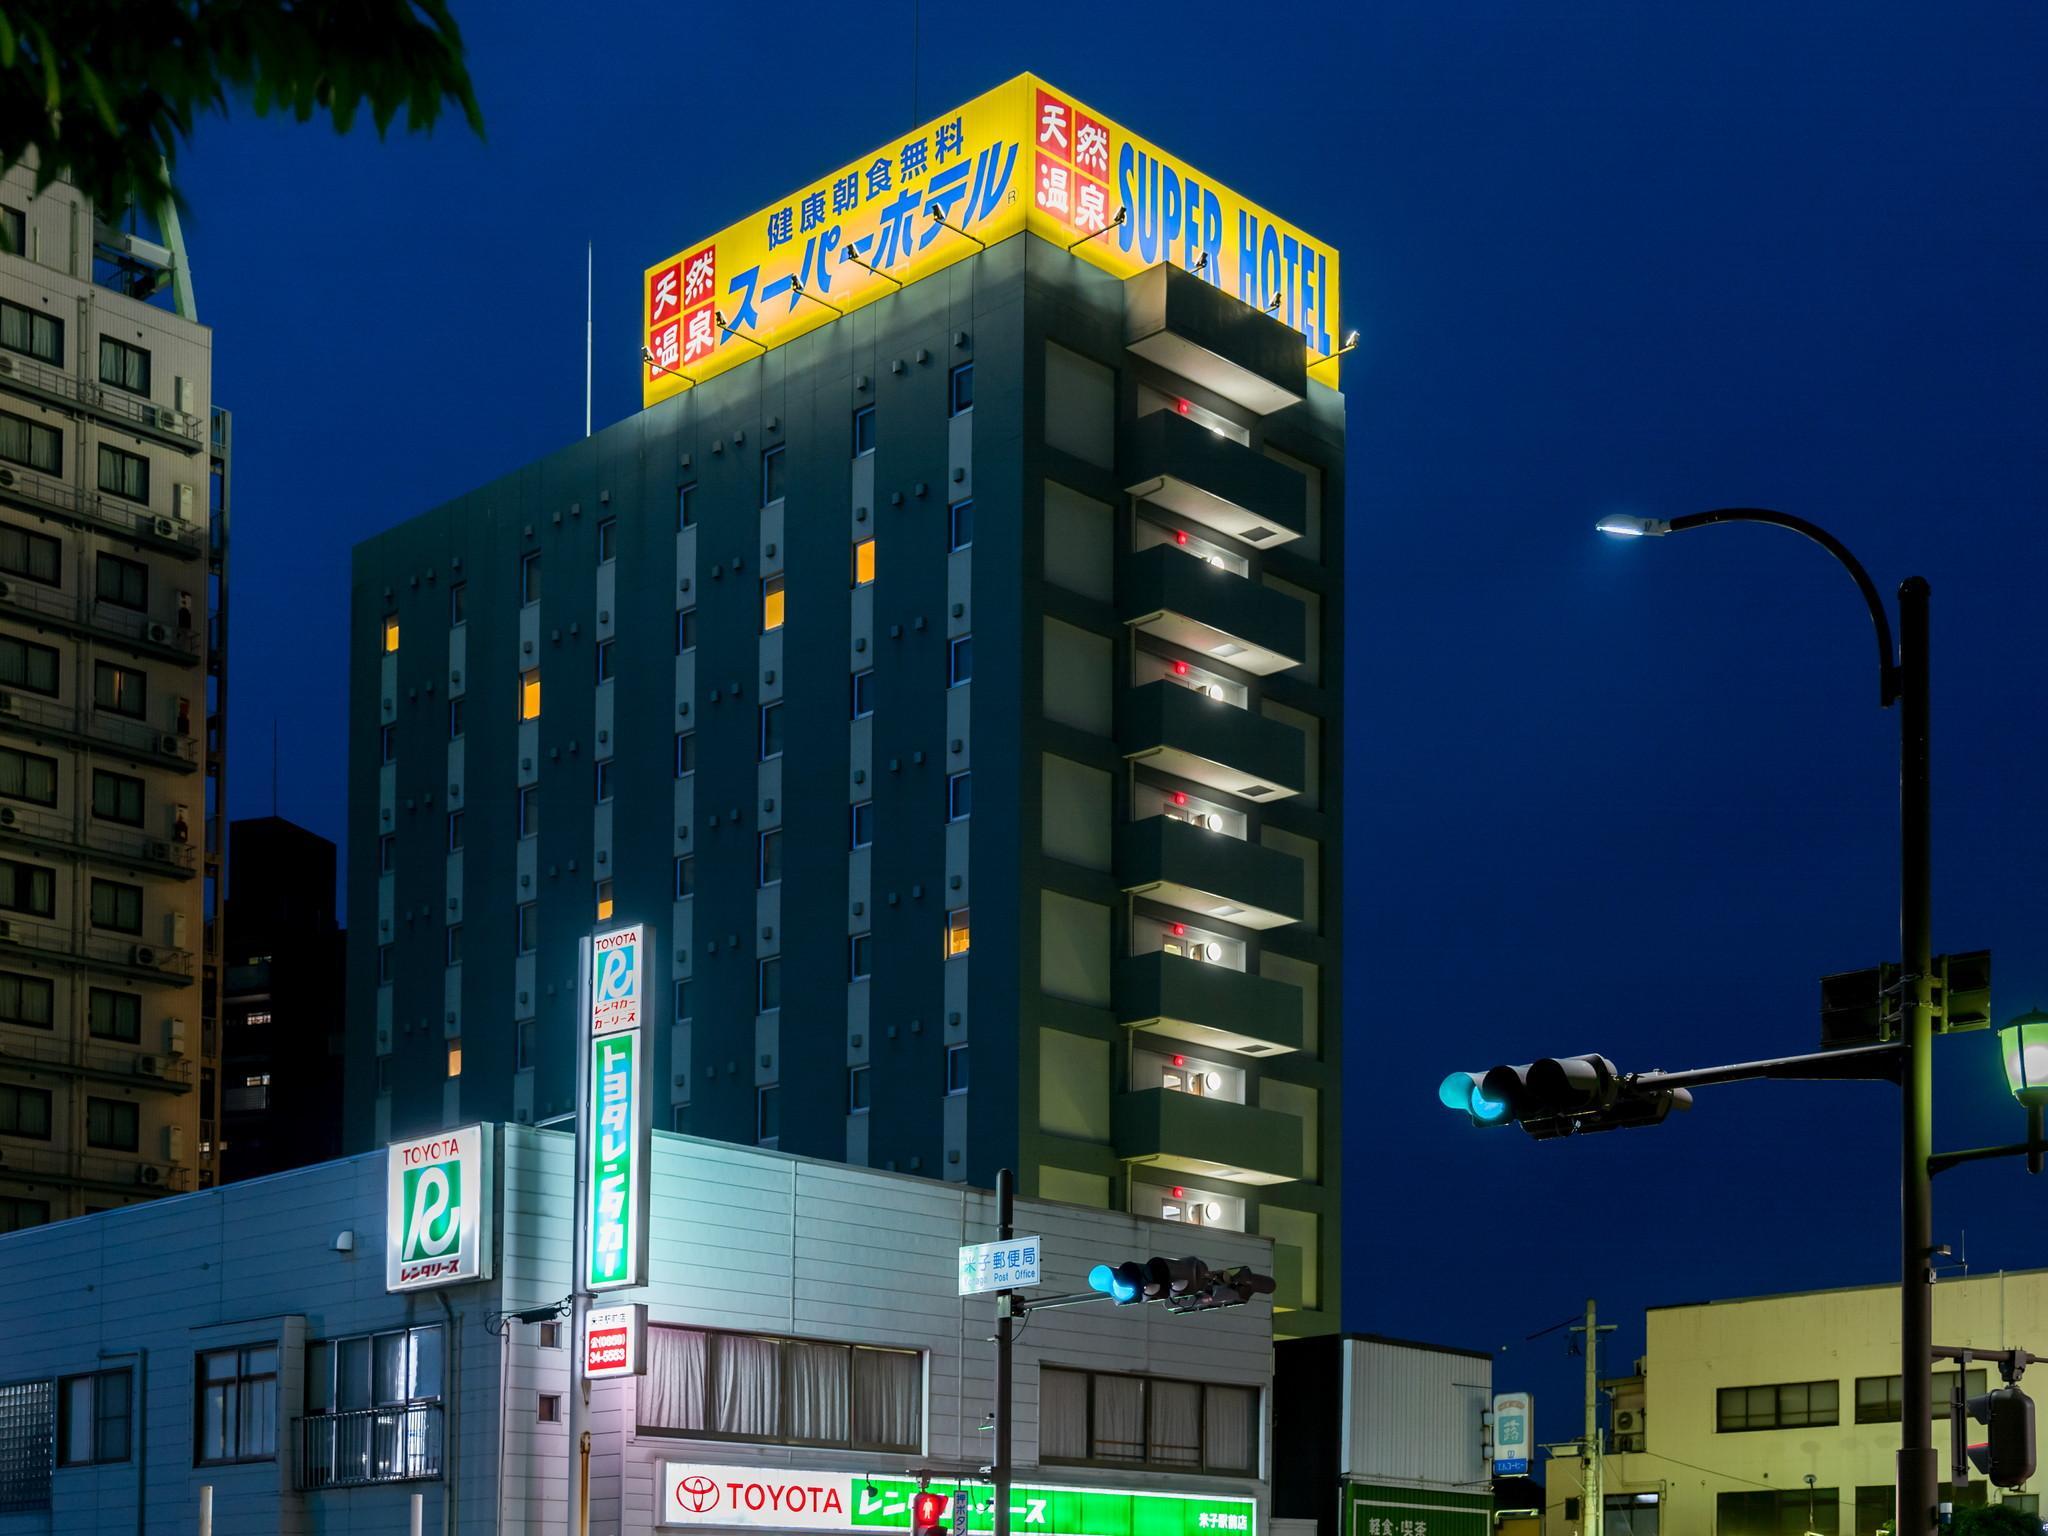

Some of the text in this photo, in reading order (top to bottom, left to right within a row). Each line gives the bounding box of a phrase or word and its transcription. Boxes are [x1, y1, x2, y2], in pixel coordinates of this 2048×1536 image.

[1040, 104, 1108, 172] 天然
[767, 116, 964, 252] 健康朝食無料
[1037, 163, 1108, 233] 温泉
[719, 140, 1020, 346] スーパーホテル
[1118, 142, 1331, 357] SUPER HOTEL
[653, 250, 715, 321] 天然
[651, 309, 715, 376] 温泉
[596, 932, 637, 951] TOYOTA
[594, 999, 636, 1015] レンタカー
[594, 1012, 636, 1029] カーリース
[402, 1138, 460, 1166] TOYOTA
[597, 1045, 628, 1278] トヨタレンタカー
[400, 1259, 460, 1282] レンタリース
[994, 1272, 1009, 1282] Post
[1015, 1269, 1036, 1280] Office
[727, 1483, 843, 1513] TOYOTA
